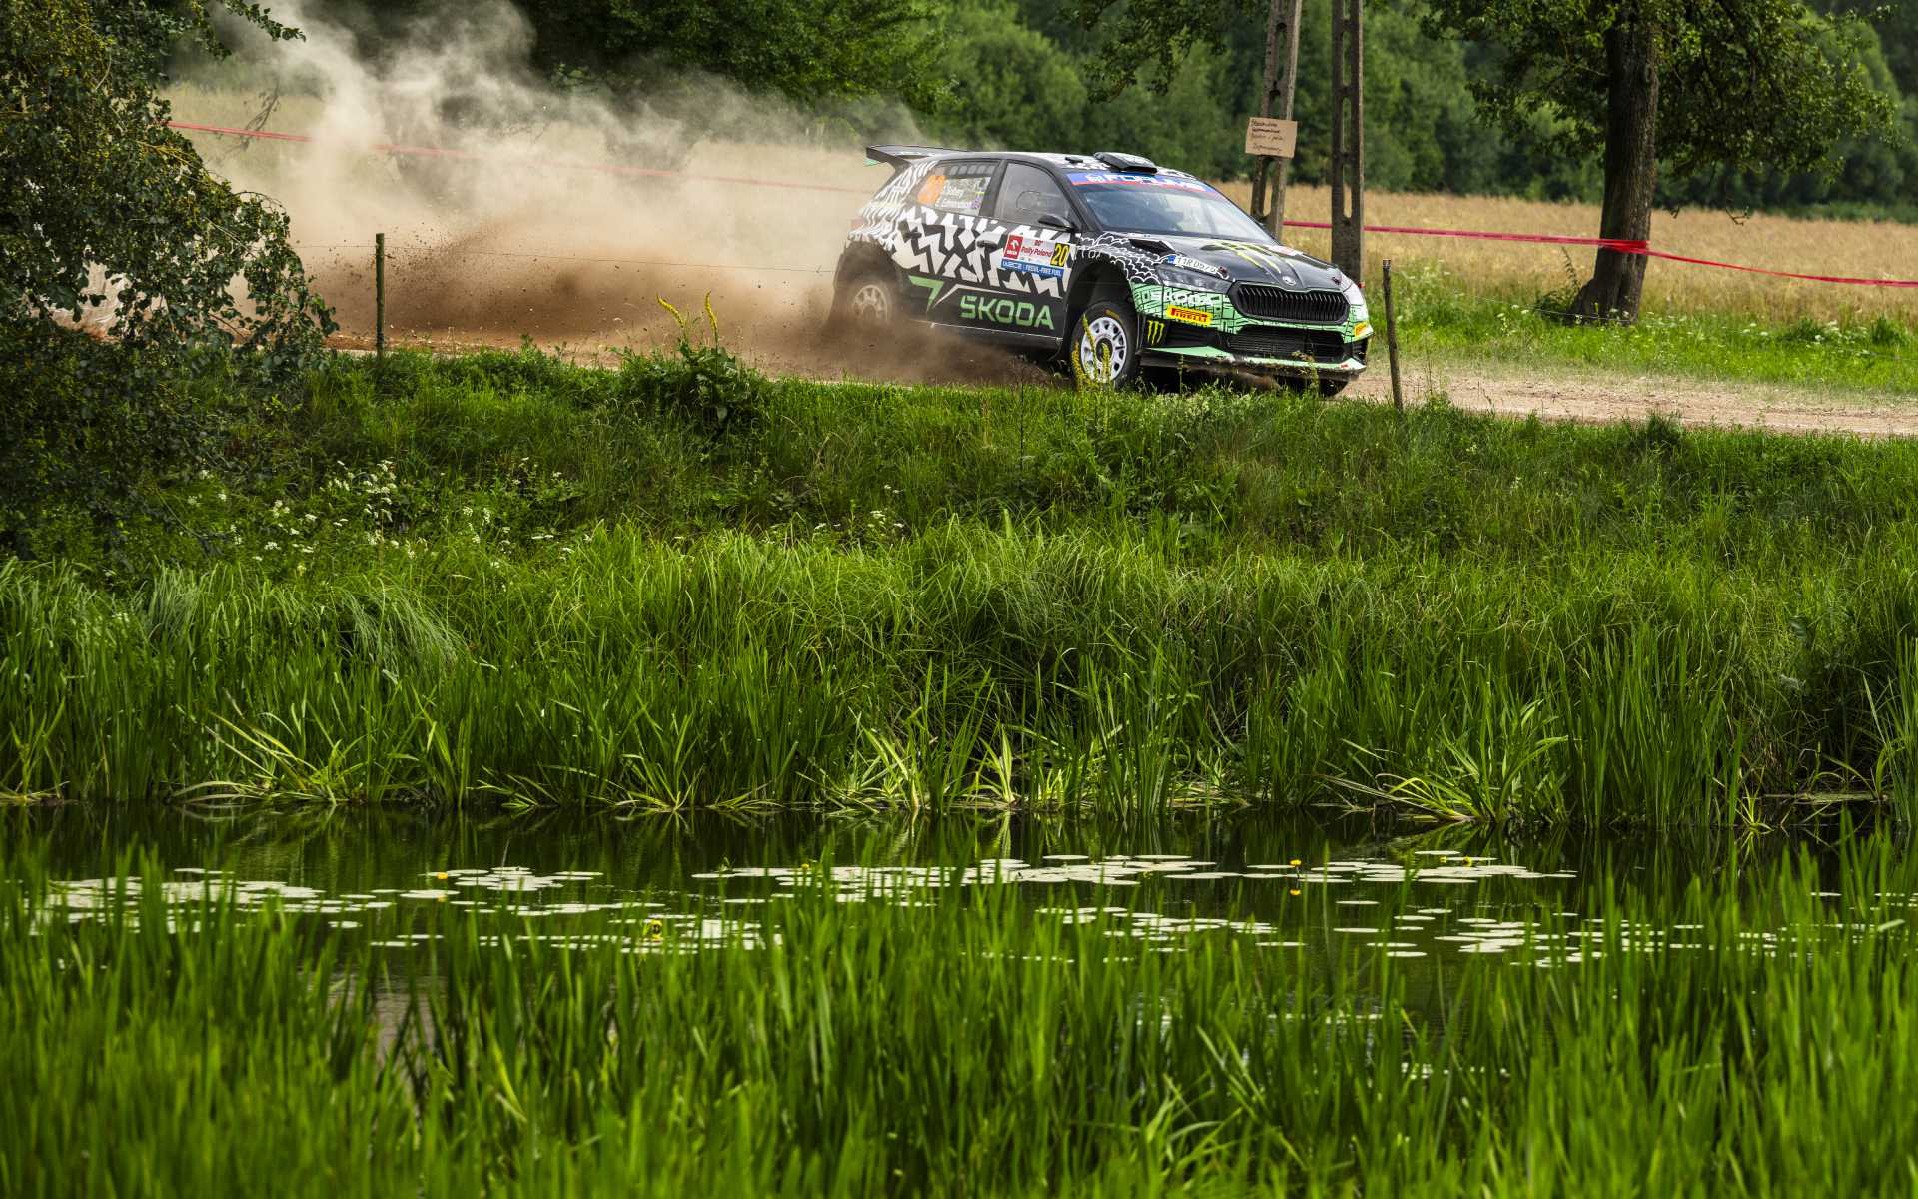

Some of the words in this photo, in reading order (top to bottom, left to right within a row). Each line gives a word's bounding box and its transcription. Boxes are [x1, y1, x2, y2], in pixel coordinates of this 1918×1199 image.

[1022, 246, 1034, 256] Rally
[1033, 248, 1052, 257] Poland
[1050, 244, 1070, 267] 20
[1171, 308, 1208, 323] PIRELLI
